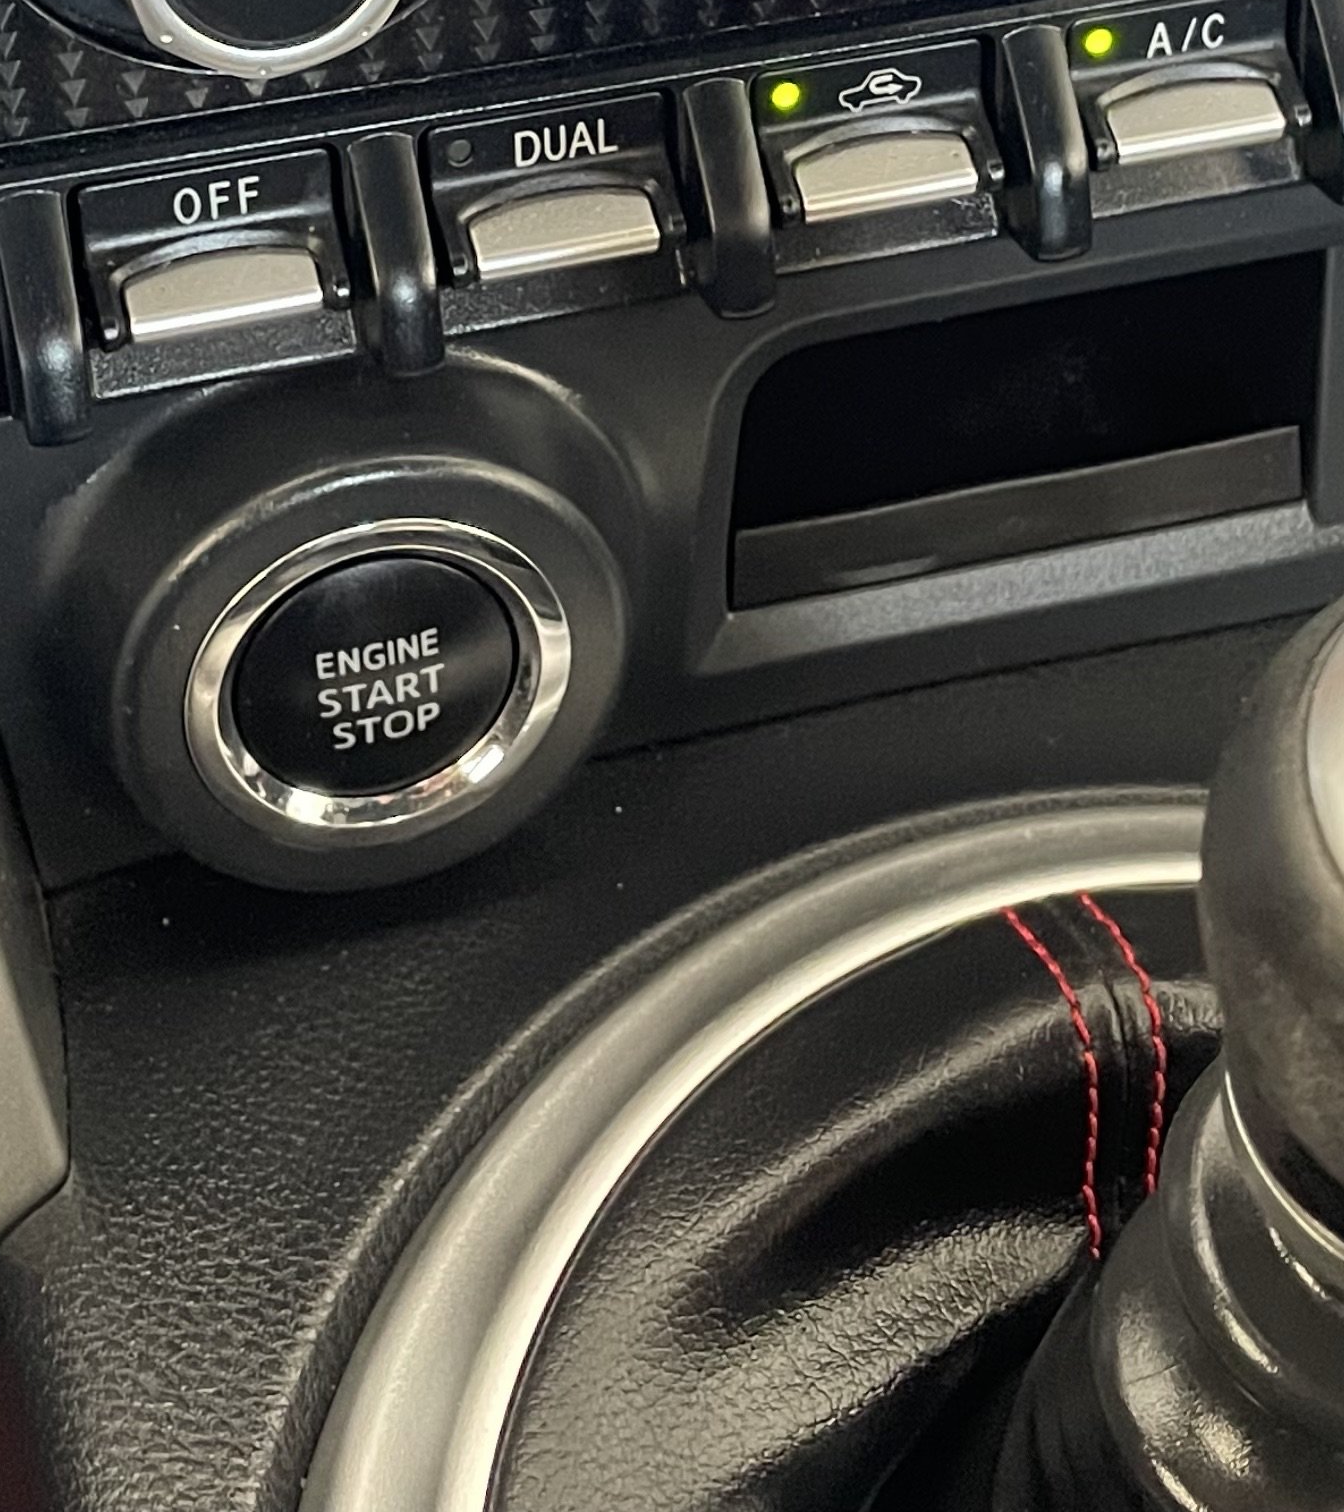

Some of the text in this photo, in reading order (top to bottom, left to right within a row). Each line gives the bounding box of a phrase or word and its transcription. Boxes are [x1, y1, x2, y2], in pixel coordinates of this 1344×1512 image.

[1145, 11, 1229, 62] A/C
[512, 118, 621, 169] DUAL
[170, 174, 265, 226] OFF
[315, 626, 440, 681] ENGINE
[317, 662, 446, 720] START
[331, 701, 442, 751] STOP
